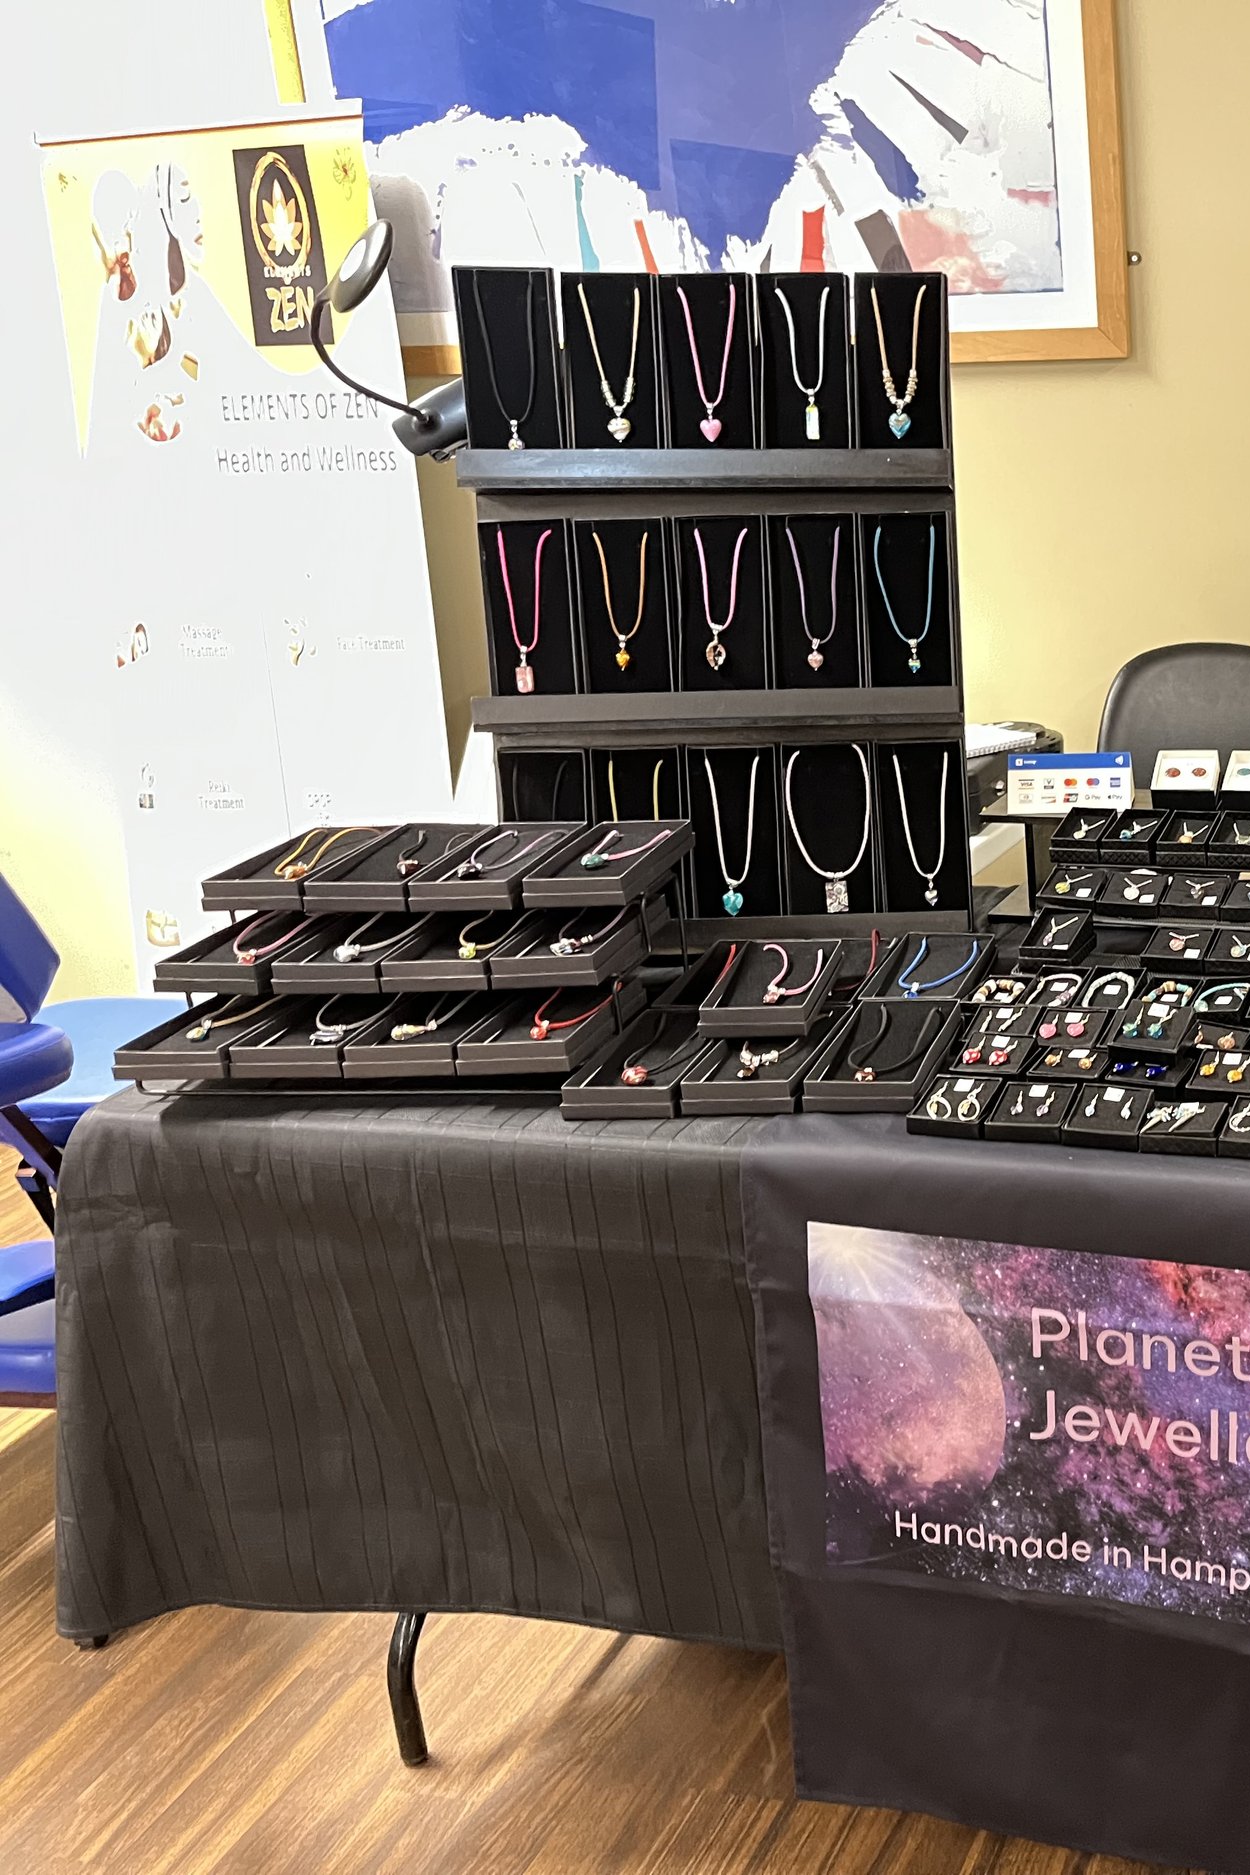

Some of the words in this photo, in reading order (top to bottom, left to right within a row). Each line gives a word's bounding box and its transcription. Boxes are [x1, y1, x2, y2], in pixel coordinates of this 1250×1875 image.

[264, 285, 315, 334] ZEN
[221, 392, 310, 422] ELEMENTS
[315, 392, 338, 420] OF
[343, 391, 379, 419] ZEN
[216, 442, 275, 473] Health
[280, 445, 312, 472] and
[316, 444, 397, 472] Wellness
[894, 1510, 1093, 1564] Handmade
[1103, 1539, 1133, 1570] in
